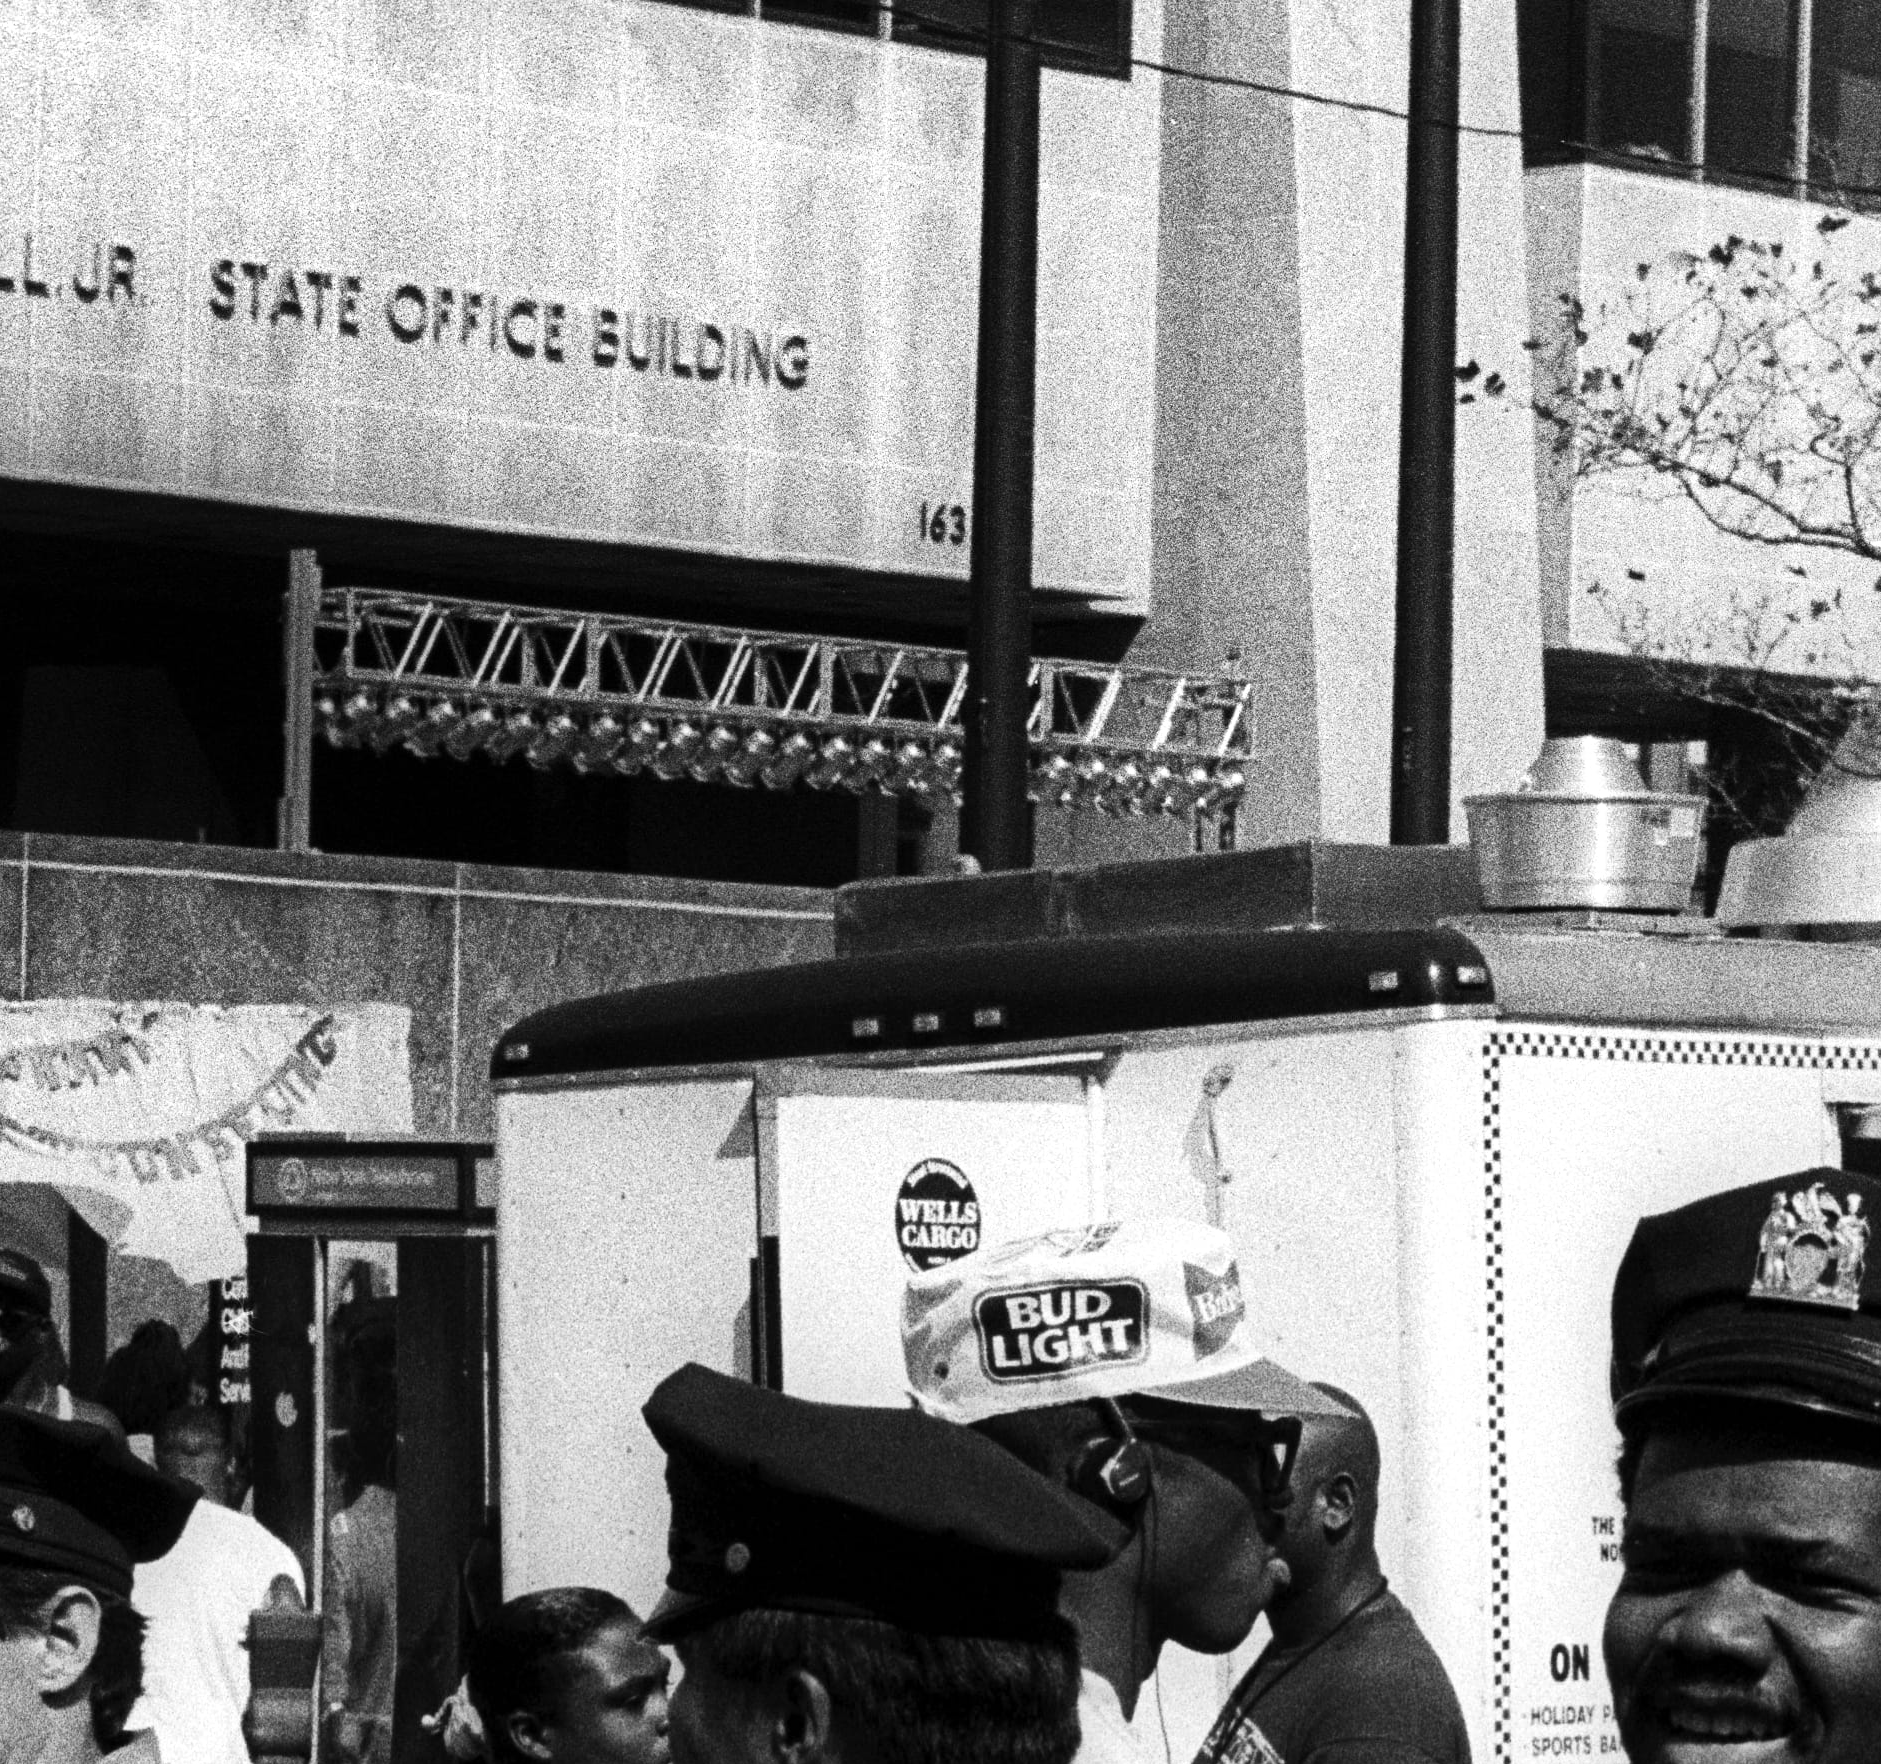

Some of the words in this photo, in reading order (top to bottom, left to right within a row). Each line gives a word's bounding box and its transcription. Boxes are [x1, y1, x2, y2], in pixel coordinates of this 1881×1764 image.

[210, 259, 364, 337] STATE
[387, 284, 565, 363] OFFICE
[592, 308, 810, 390] BUILDING
[919, 501, 965, 546] 163
[898, 1198, 978, 1224] WELLS
[901, 1224, 977, 1249] CARGO
[1005, 1288, 1113, 1330] BUD
[991, 1317, 1135, 1368] LIGHT
[1591, 1516, 1615, 1538] THE
[1600, 1543, 1621, 1563] NO
[1550, 1643, 1590, 1683] ON
[1530, 1705, 1597, 1726] HOLIDAY
[1531, 1735, 1593, 1757] SPORTS
[1600, 1736, 1622, 1755] BA
